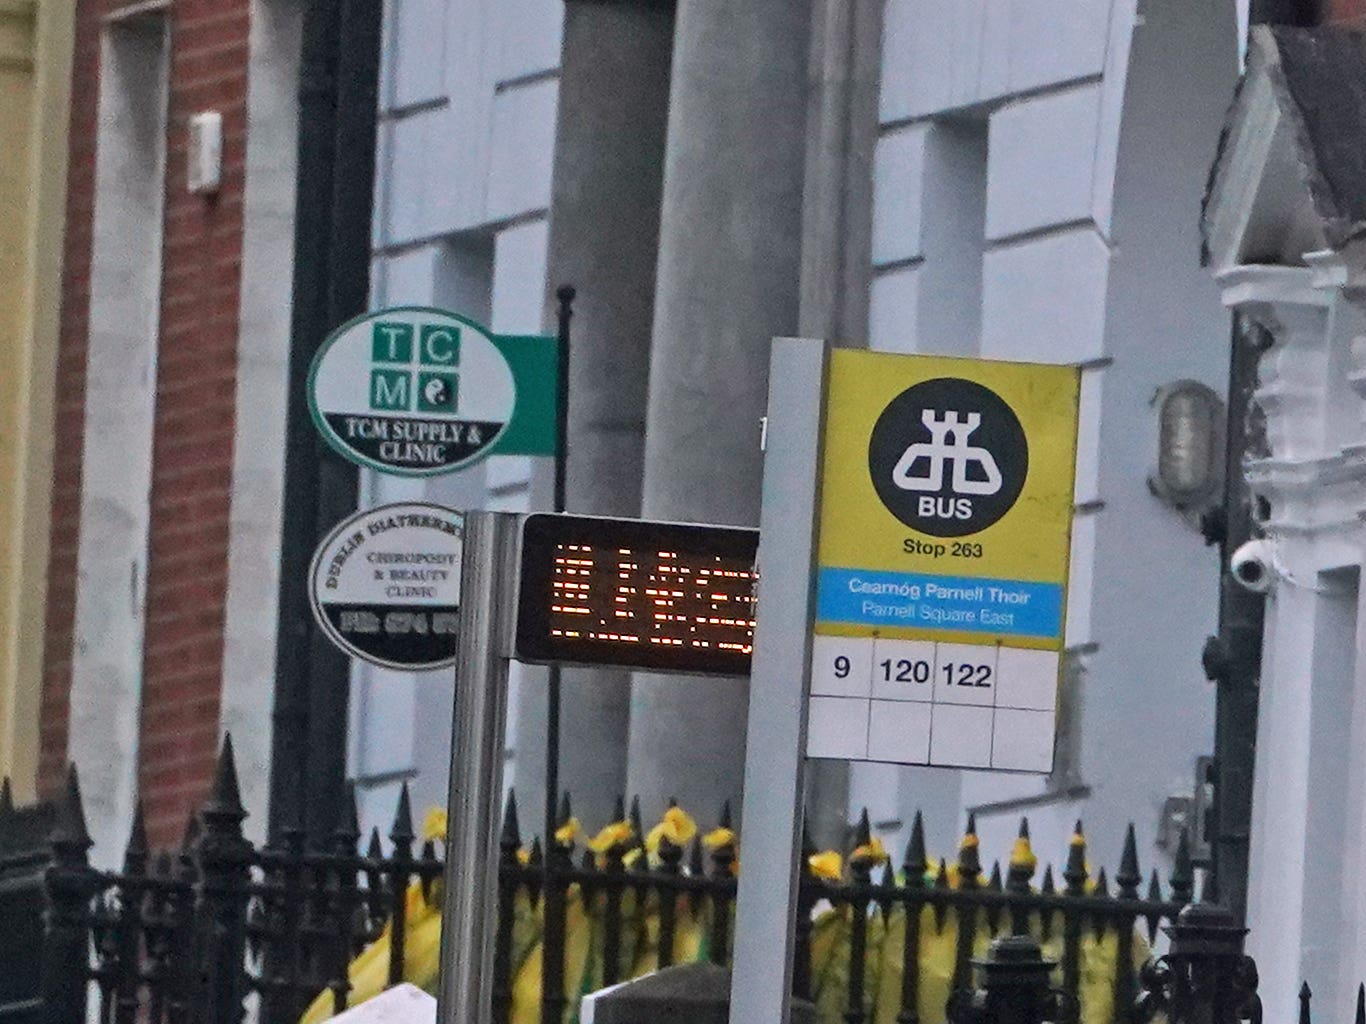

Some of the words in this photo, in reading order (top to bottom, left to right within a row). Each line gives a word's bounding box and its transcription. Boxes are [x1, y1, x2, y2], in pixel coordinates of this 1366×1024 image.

[345, 418, 388, 439] TCM
[392, 420, 463, 443] SUPPLY
[466, 424, 481, 445] &
[379, 441, 446, 463] CLINIC
[918, 496, 973, 520] BUS
[903, 538, 945, 559] Stop
[951, 542, 983, 558] 263
[389, 569, 449, 581] BEAUTY
[385, 586, 437, 599] CLINIC
[848, 578, 921, 600] Cearnóg
[925, 583, 984, 601] Parnell
[988, 586, 1032, 605] Thoir
[862, 601, 916, 618] Parnell
[920, 604, 977, 624] Square
[980, 608, 1015, 625] East
[834, 655, 851, 679] 9
[880, 659, 929, 684] 120
[942, 663, 992, 688] 122
